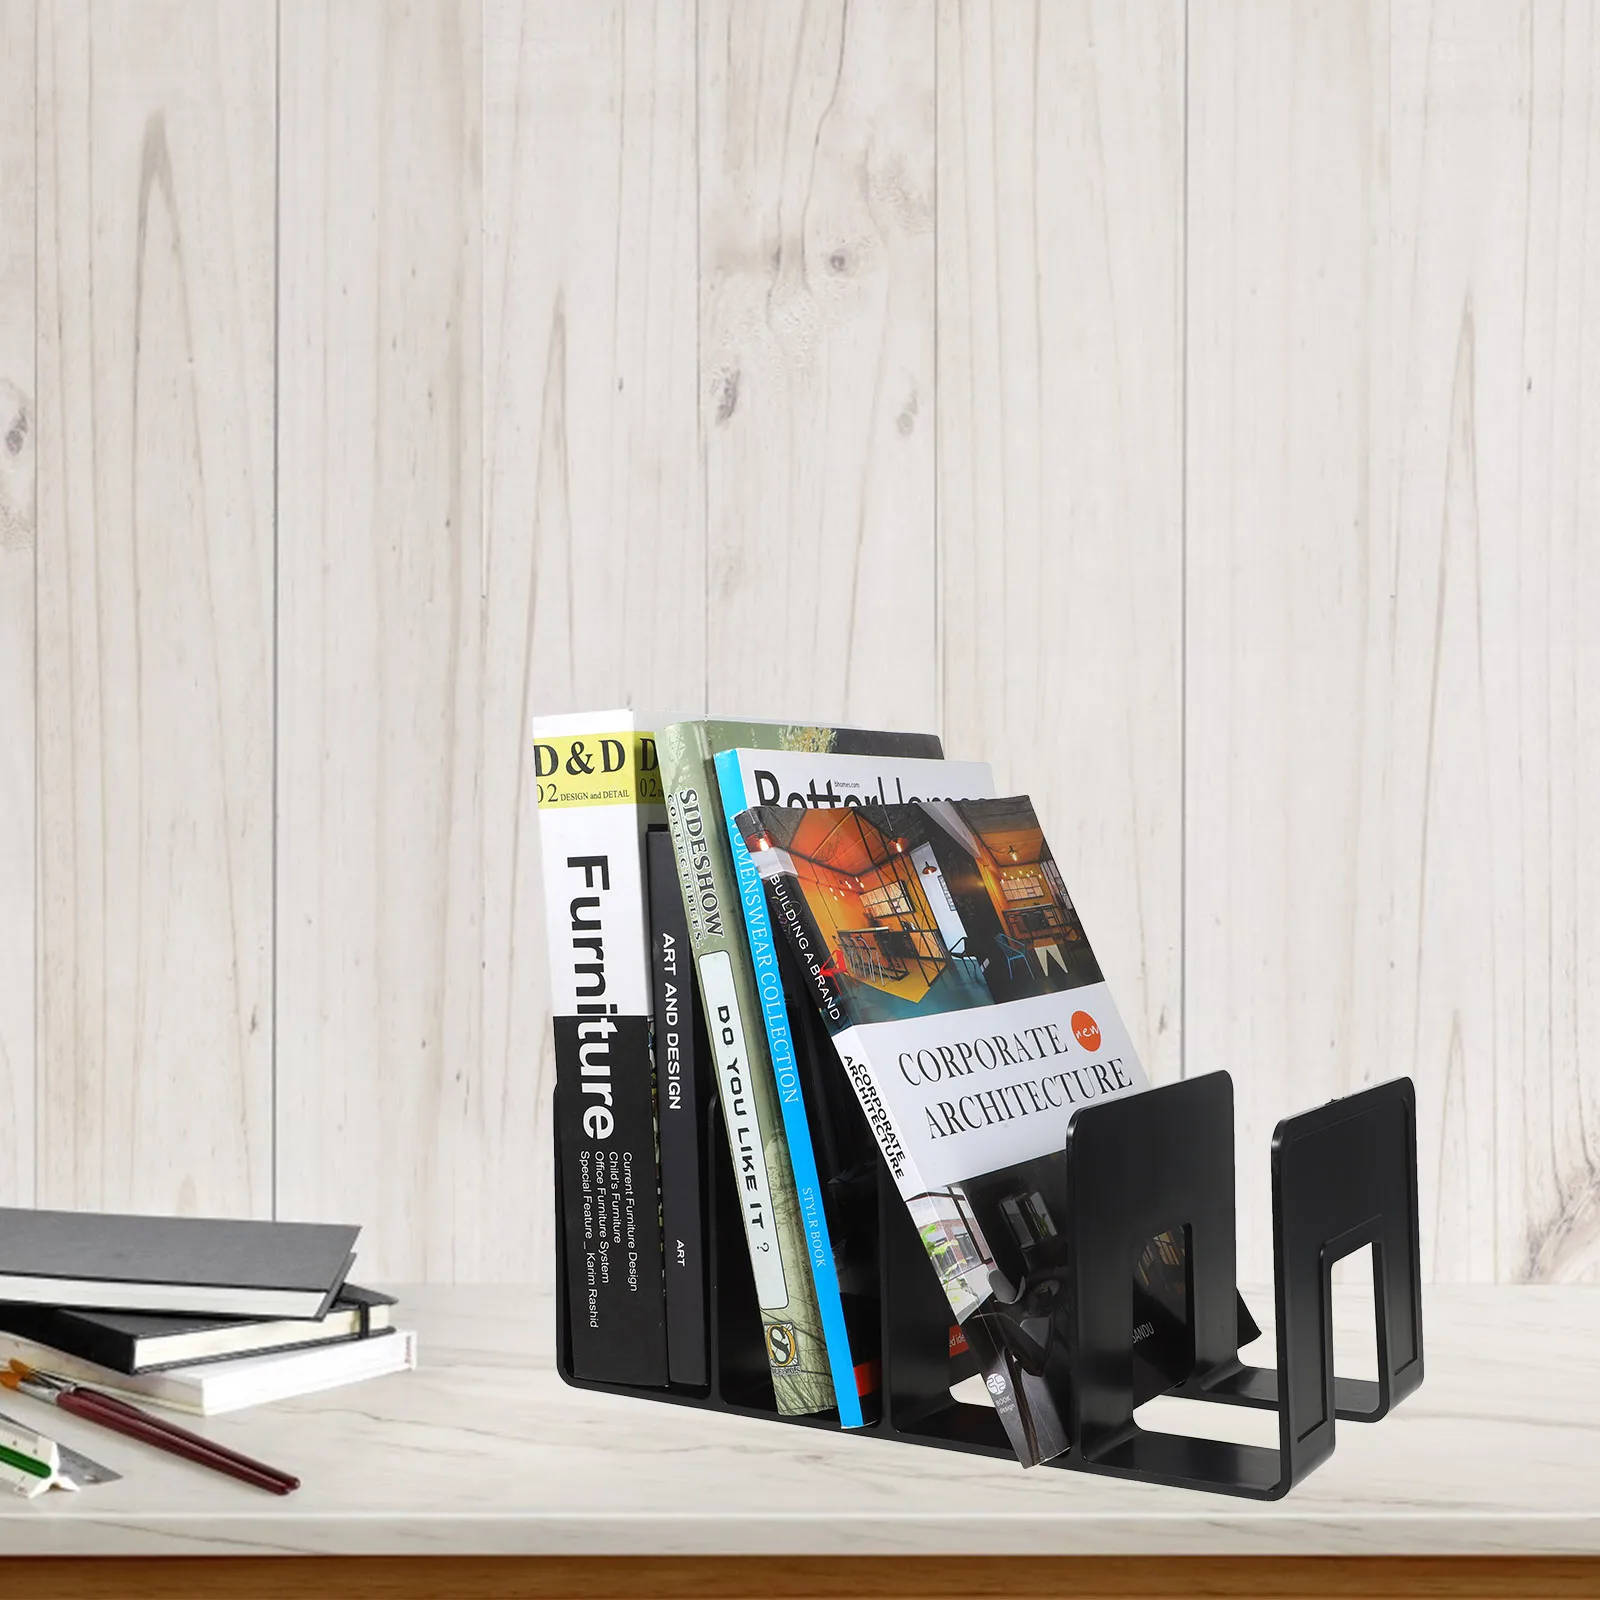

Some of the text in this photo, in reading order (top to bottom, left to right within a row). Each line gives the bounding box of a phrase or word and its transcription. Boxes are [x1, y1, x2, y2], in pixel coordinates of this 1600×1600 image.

[560, 792, 589, 801] DESIGN
[590, 791, 601, 799] and
[603, 789, 630, 799] DETAIL
[679, 789, 724, 937] SIDESHOW
[730, 809, 799, 1103] OMENSWEAR COLLECTION
[769, 873, 841, 1021] BUILDING A BRAND
[567, 855, 618, 1140] Furniture
[662, 932, 682, 1110] ART AND DESIGN
[1075, 1025, 1099, 1040] new
[898, 1023, 1069, 1086] CORPORATE
[924, 1058, 1133, 1140] ARCHITECTURE
[717, 1005, 770, 1253] DO YOU LIKE IT ?
[844, 1055, 905, 1179] ARCHITECTURE
[858, 1063, 906, 1160] CORPORATE
[579, 1150, 591, 1193] Special
[583, 1195, 593, 1239] Feature
[609, 1152, 621, 1244] Child's Furniture
[595, 1152, 610, 1284] Office Furniture System
[622, 1152, 638, 1292] Current Furniture Design
[676, 1239, 686, 1267] ART
[802, 1187, 826, 1268] STYLR BOOK
[586, 1252, 596, 1286] Karim
[588, 1289, 599, 1328] Rashid
